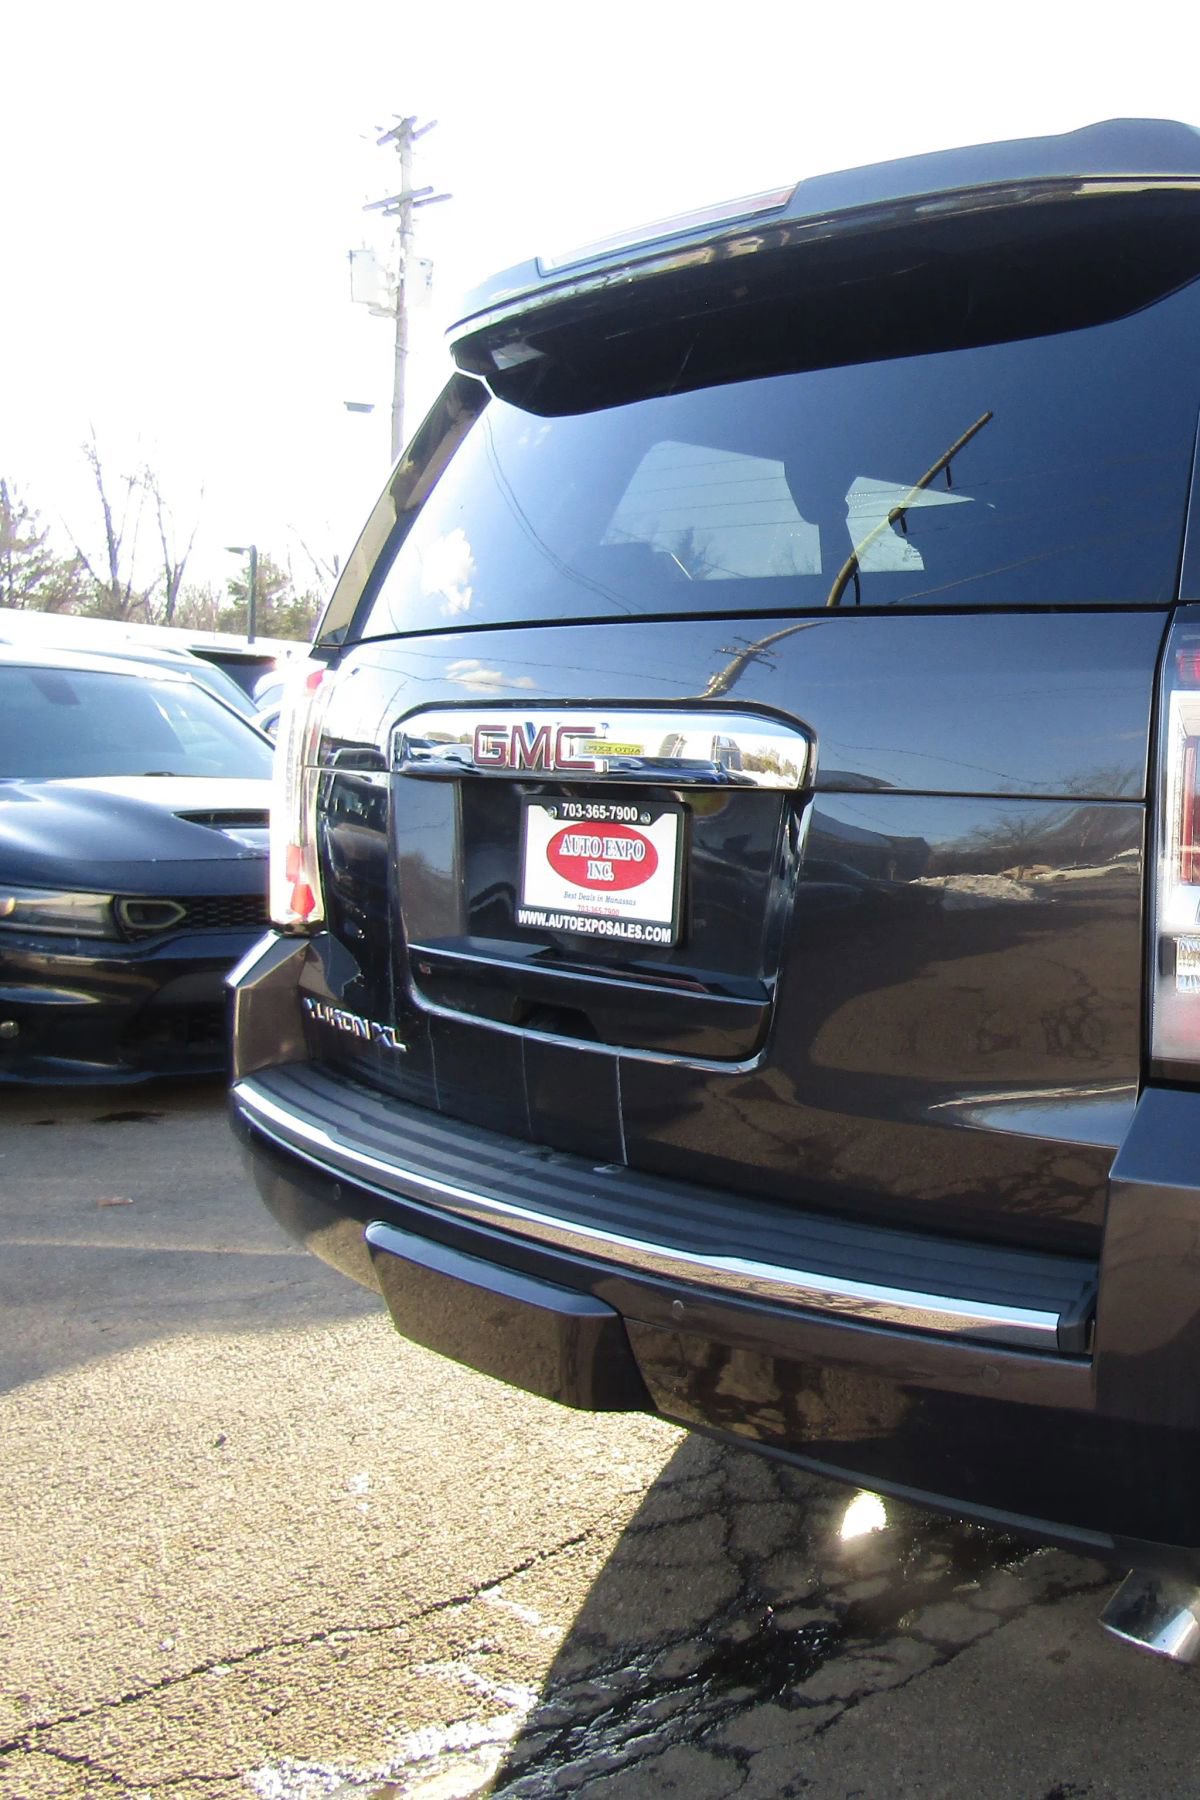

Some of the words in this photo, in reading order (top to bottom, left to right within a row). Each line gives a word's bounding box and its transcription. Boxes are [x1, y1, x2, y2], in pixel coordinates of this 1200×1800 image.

[473, 723, 598, 768] GMC
[562, 802, 638, 821] 703-365-7900
[560, 835, 602, 858] AUTO
[602, 838, 646, 862] EXPO
[587, 861, 614, 881] INC.
[564, 891, 577, 899] Best
[579, 892, 596, 901] Deals
[518, 909, 671, 943] WWW.AUTOEXPOSALES.COM
